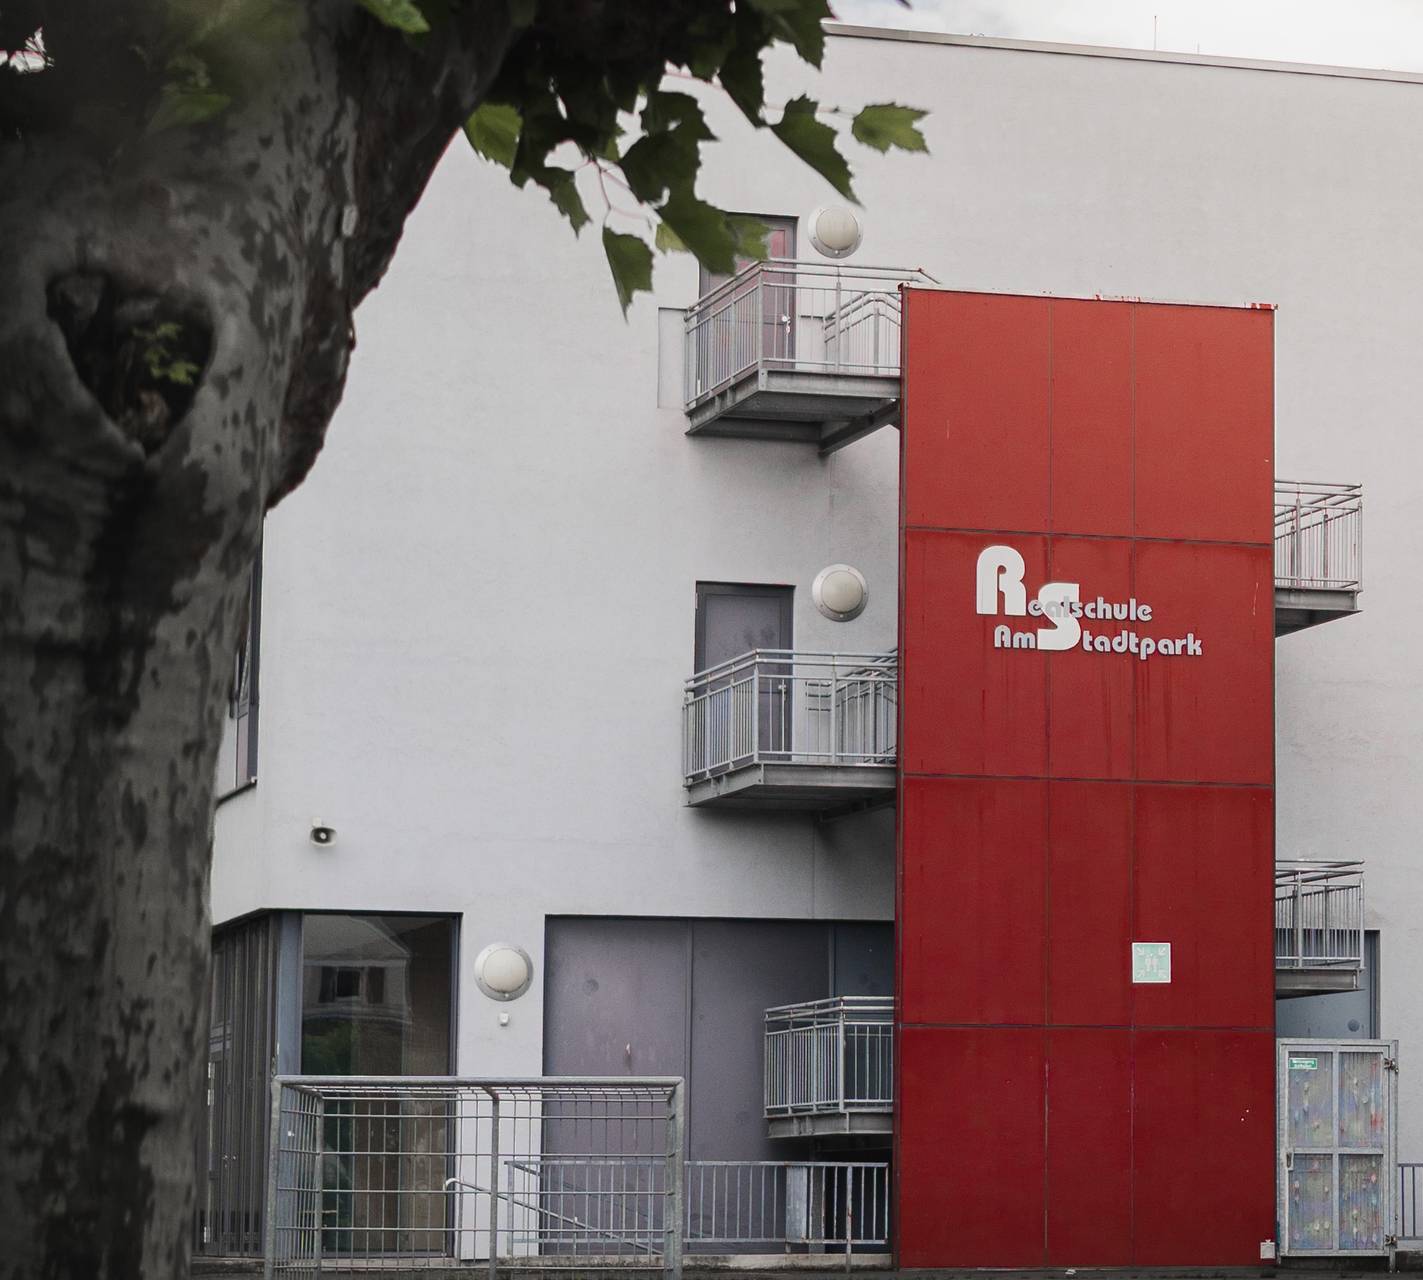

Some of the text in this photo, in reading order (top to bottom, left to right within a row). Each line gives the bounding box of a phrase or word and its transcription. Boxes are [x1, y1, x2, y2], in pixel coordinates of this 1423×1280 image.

[976, 545, 1153, 621] Realschule
[994, 582, 1203, 660] Am Stadtpark
